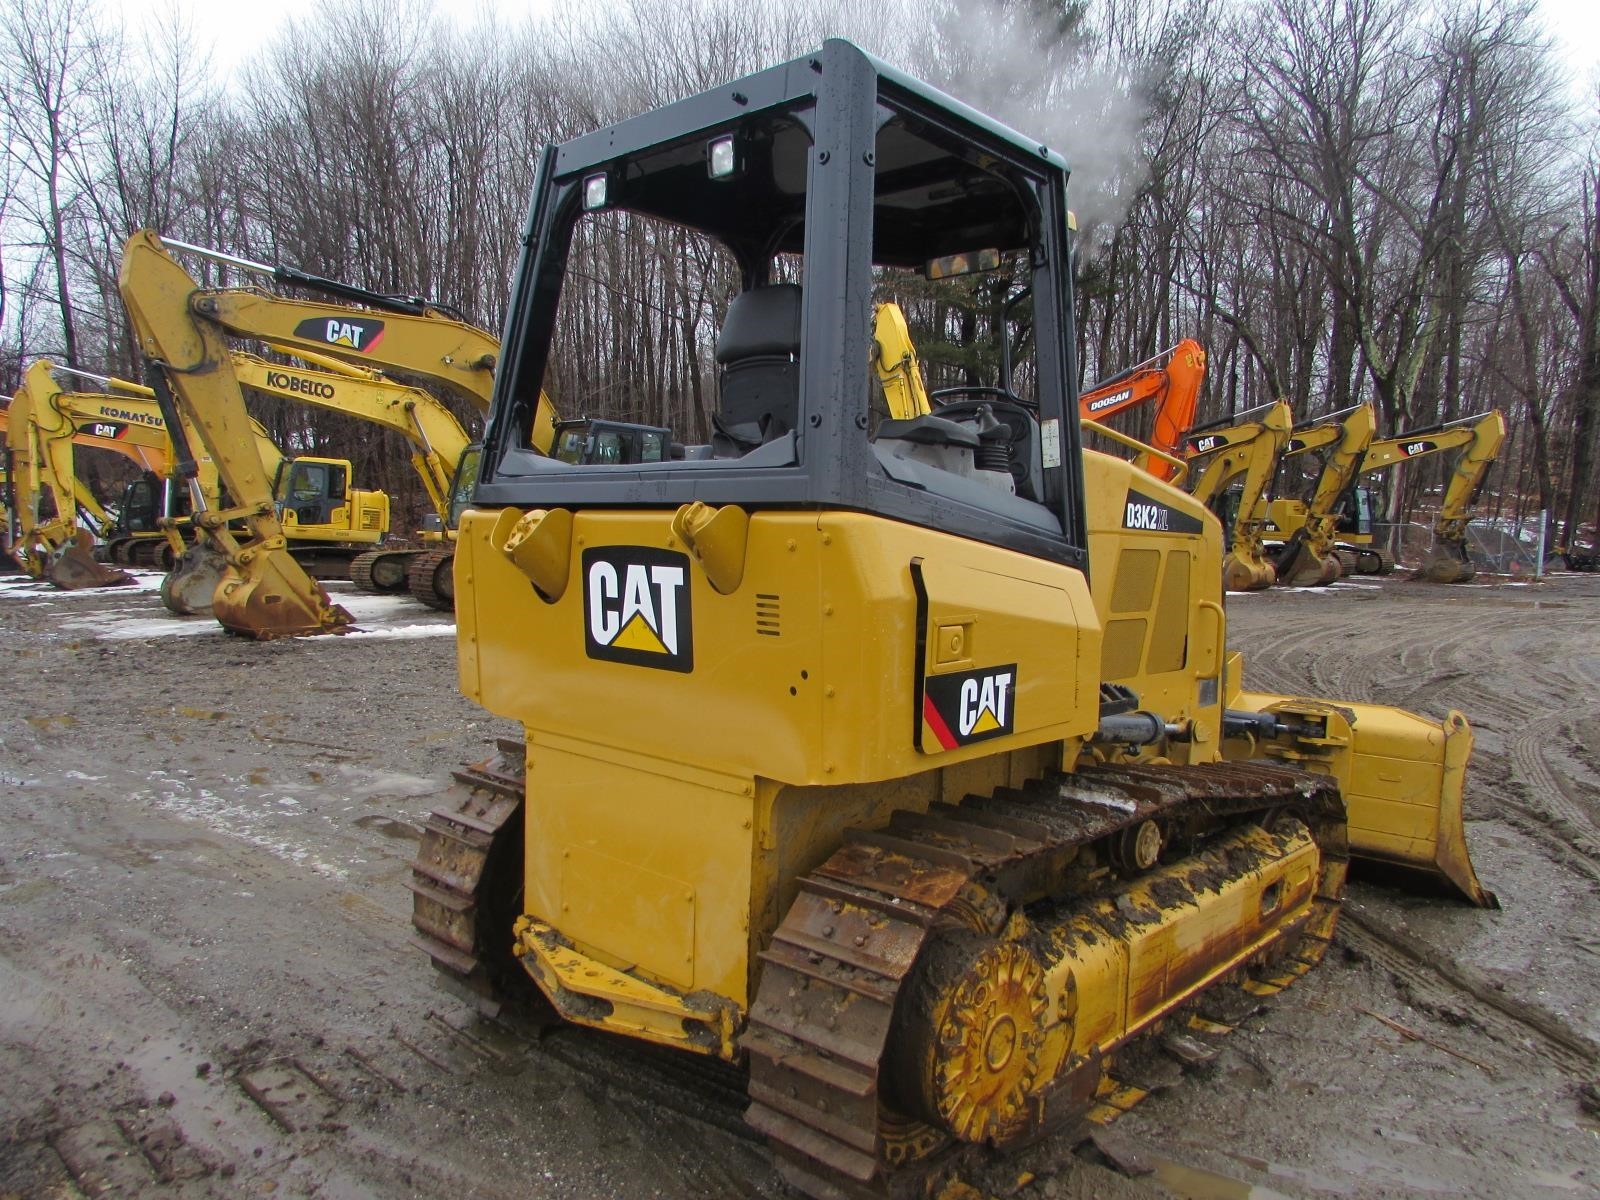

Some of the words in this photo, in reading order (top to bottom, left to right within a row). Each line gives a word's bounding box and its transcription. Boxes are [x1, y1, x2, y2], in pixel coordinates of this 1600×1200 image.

[326, 320, 363, 348] CAT
[267, 371, 335, 399] KOBELCO
[1090, 391, 1129, 411] DOOSAN
[100, 406, 164, 427] KOMATSU
[95, 424, 116, 437] CAT
[1198, 436, 1215, 451] CAT
[1407, 442, 1424, 455] CAT
[589, 560, 684, 656] CAT
[959, 672, 1012, 736] CAT
